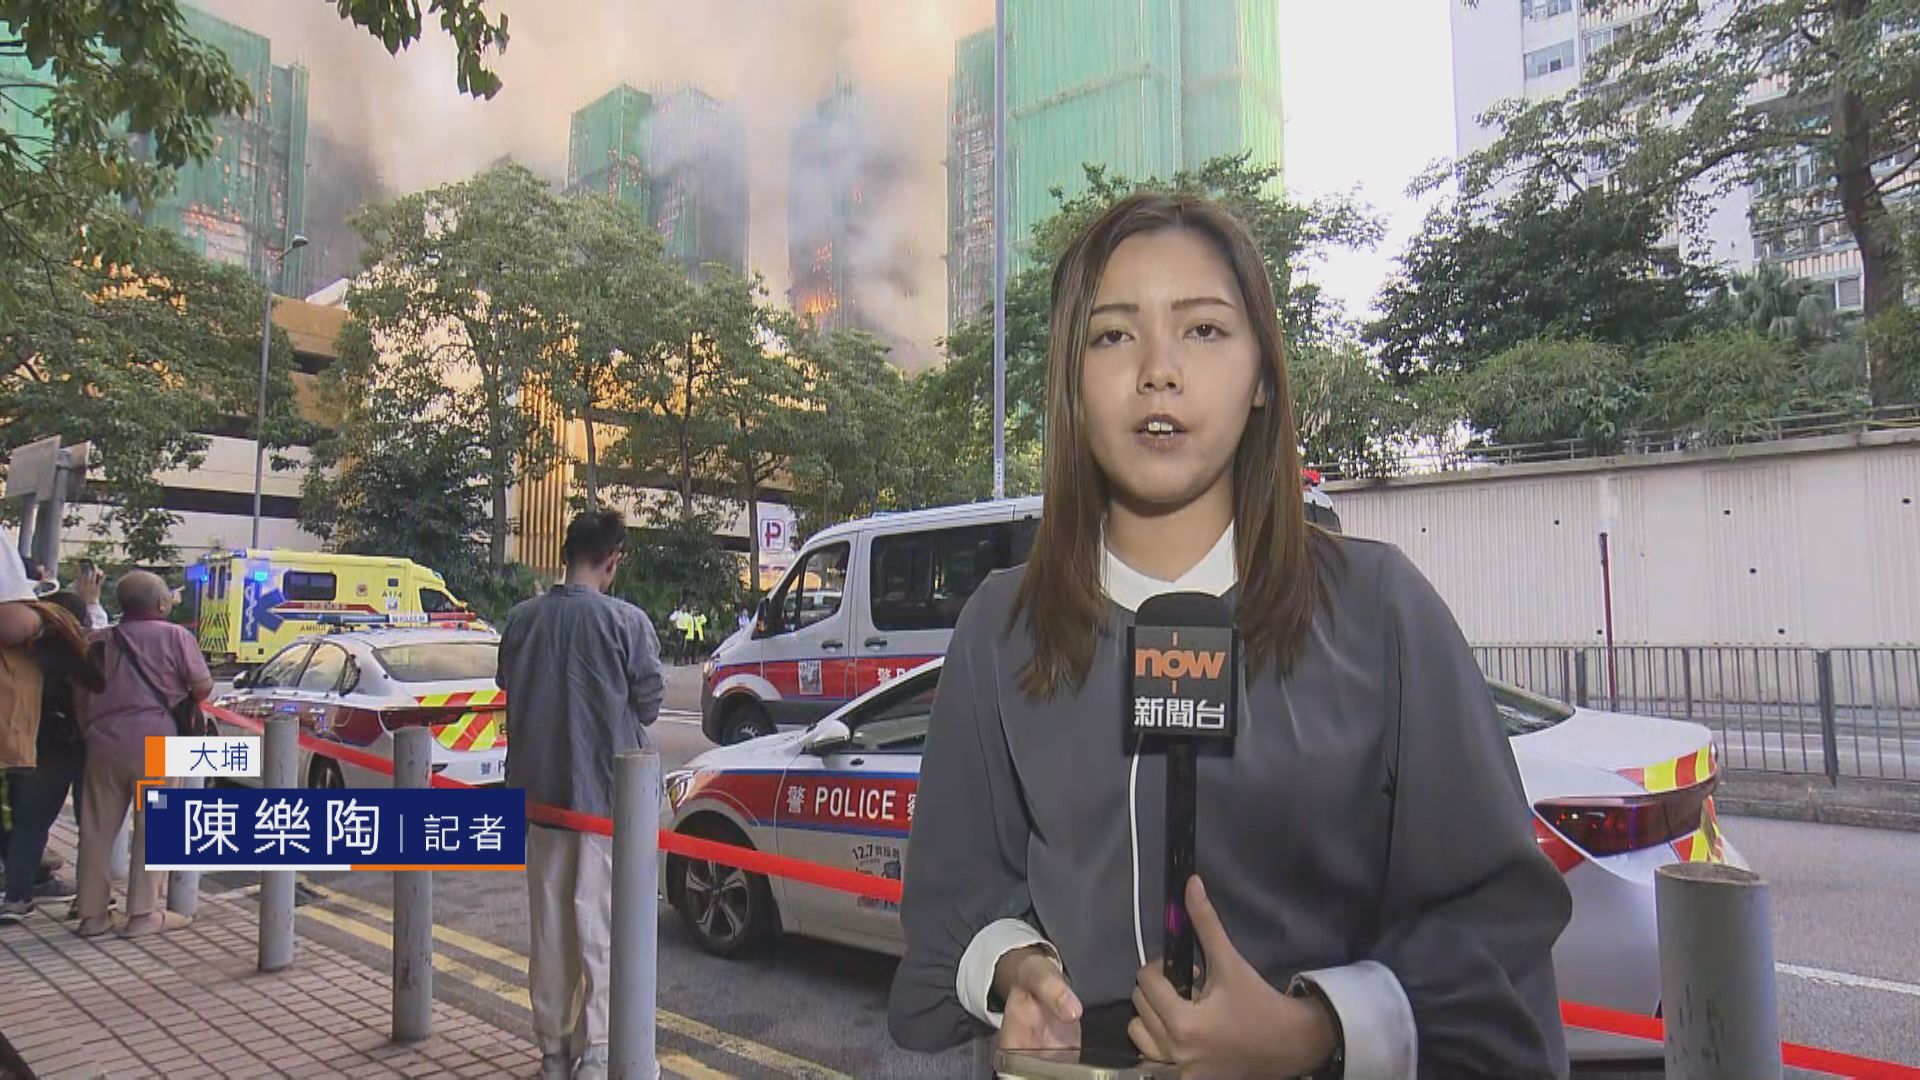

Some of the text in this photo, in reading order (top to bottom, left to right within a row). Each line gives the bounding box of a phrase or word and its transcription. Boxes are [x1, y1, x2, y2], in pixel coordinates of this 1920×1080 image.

[1135, 648, 1226, 679] now
[1134, 696, 1225, 729] 新聞台
[815, 786, 896, 820] POLICE
